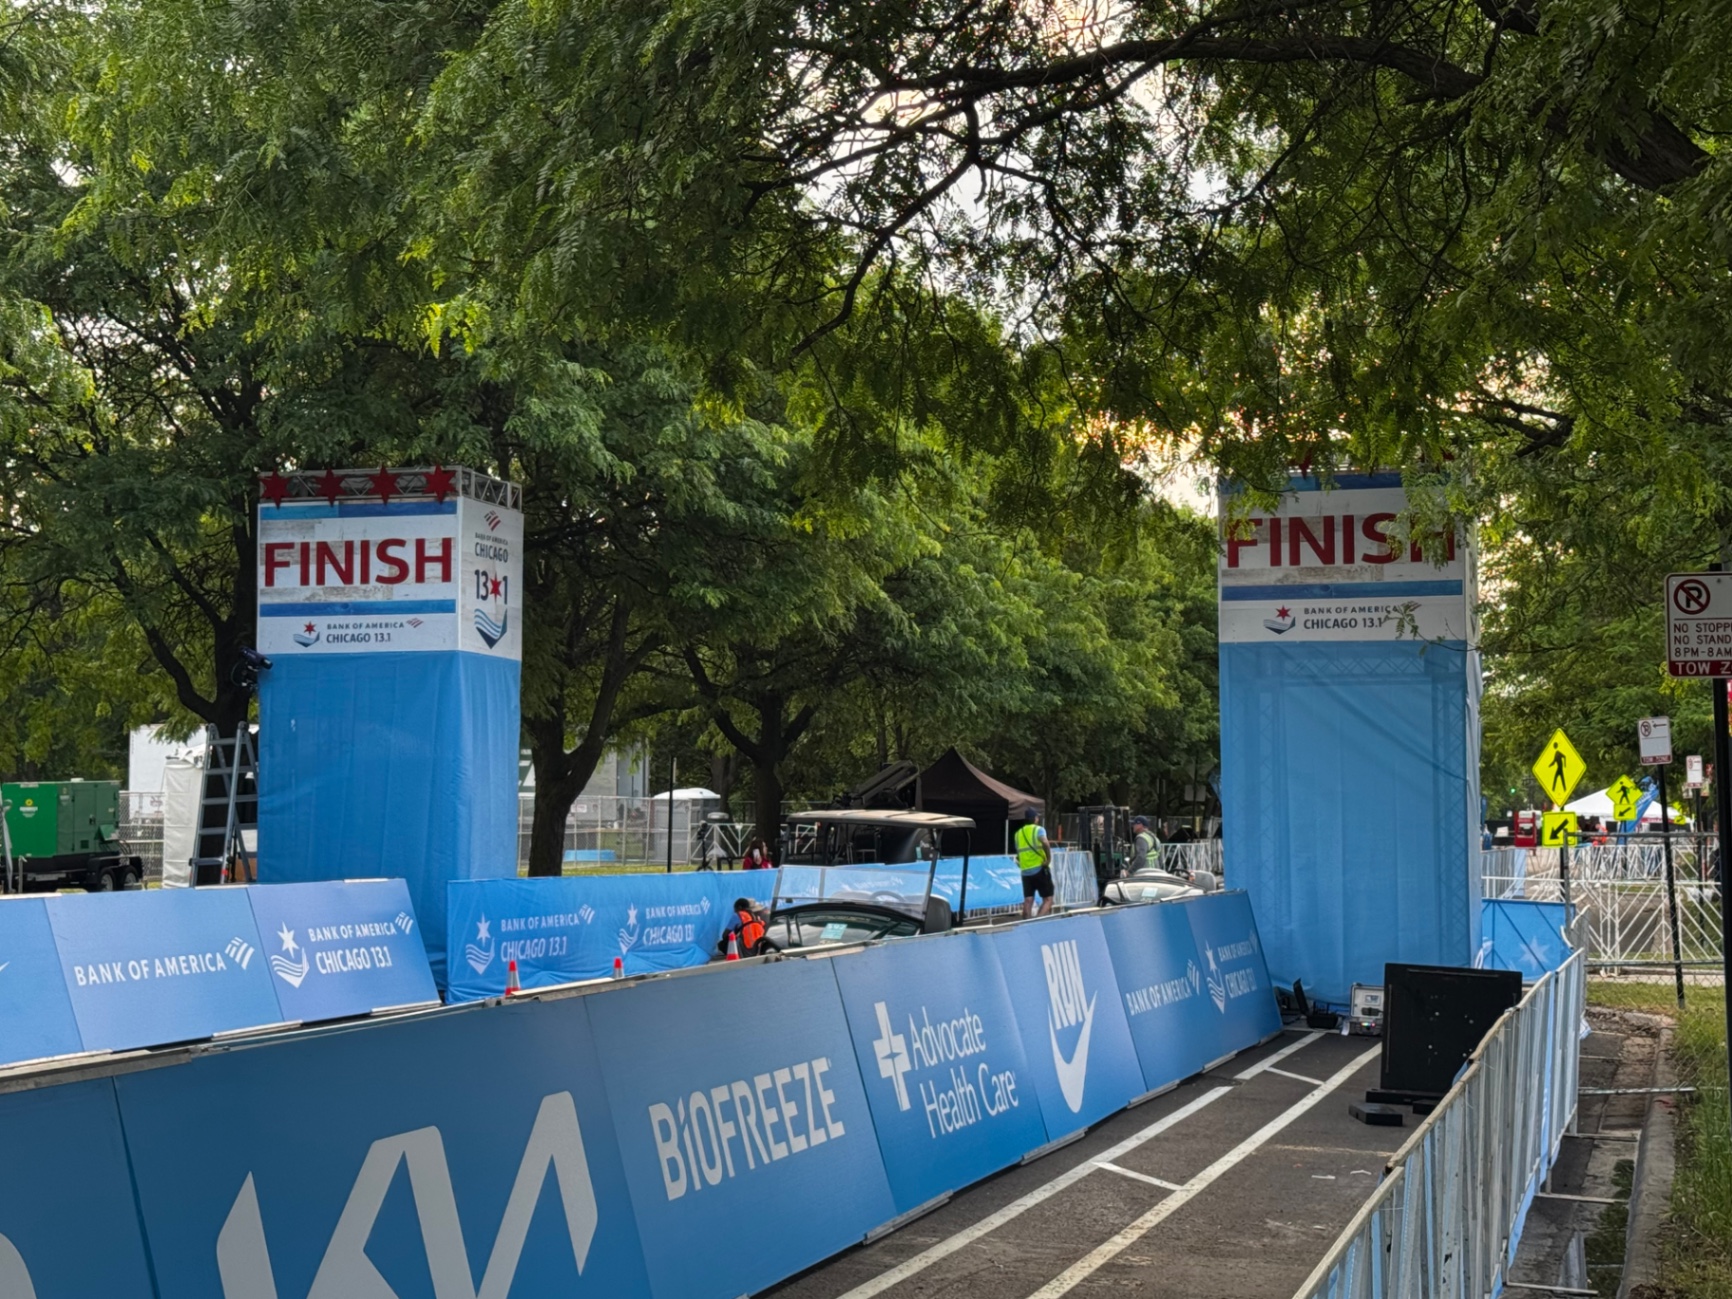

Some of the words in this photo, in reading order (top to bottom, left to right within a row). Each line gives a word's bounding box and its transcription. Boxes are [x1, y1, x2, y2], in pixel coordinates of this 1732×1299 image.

[264, 537, 452, 587] FINISH
[475, 542, 508, 563] CHICAGO
[1303, 607, 1332, 615] BANK
[1335, 606, 1348, 614] OF
[1350, 605, 1398, 614] AMERICA
[1303, 618, 1358, 629] CHICAGO
[1362, 617, 1382, 628] 13.1
[1674, 623, 1688, 633] NO
[326, 633, 371, 643] CHICAGO
[374, 632, 391, 643] 13.1
[1674, 635, 1690, 645] NO
[1675, 662, 1711, 675] TOW
[667, 905, 676, 917] OF
[308, 926, 340, 942] BANK
[340, 924, 354, 939] OF
[355, 922, 398, 938] AMERICA
[501, 918, 526, 932] BANK
[528, 916, 539, 929] OF
[541, 913, 580, 929] AMERICA
[643, 924, 684, 946] CHICAGO
[501, 937, 546, 963] CHICAGO
[548, 935, 567, 956] 13.1
[73, 962, 126, 986] BANK
[128, 959, 149, 980] OF
[154, 952, 227, 978] AMERICA
[315, 947, 371, 974] CHICAGO
[1041, 939, 1088, 1030] RUN
[1126, 988, 1152, 1016] BANK
[909, 1005, 986, 1070] Advocate
[919, 1065, 982, 1139] Health
[977, 1062, 1019, 1116] Care
